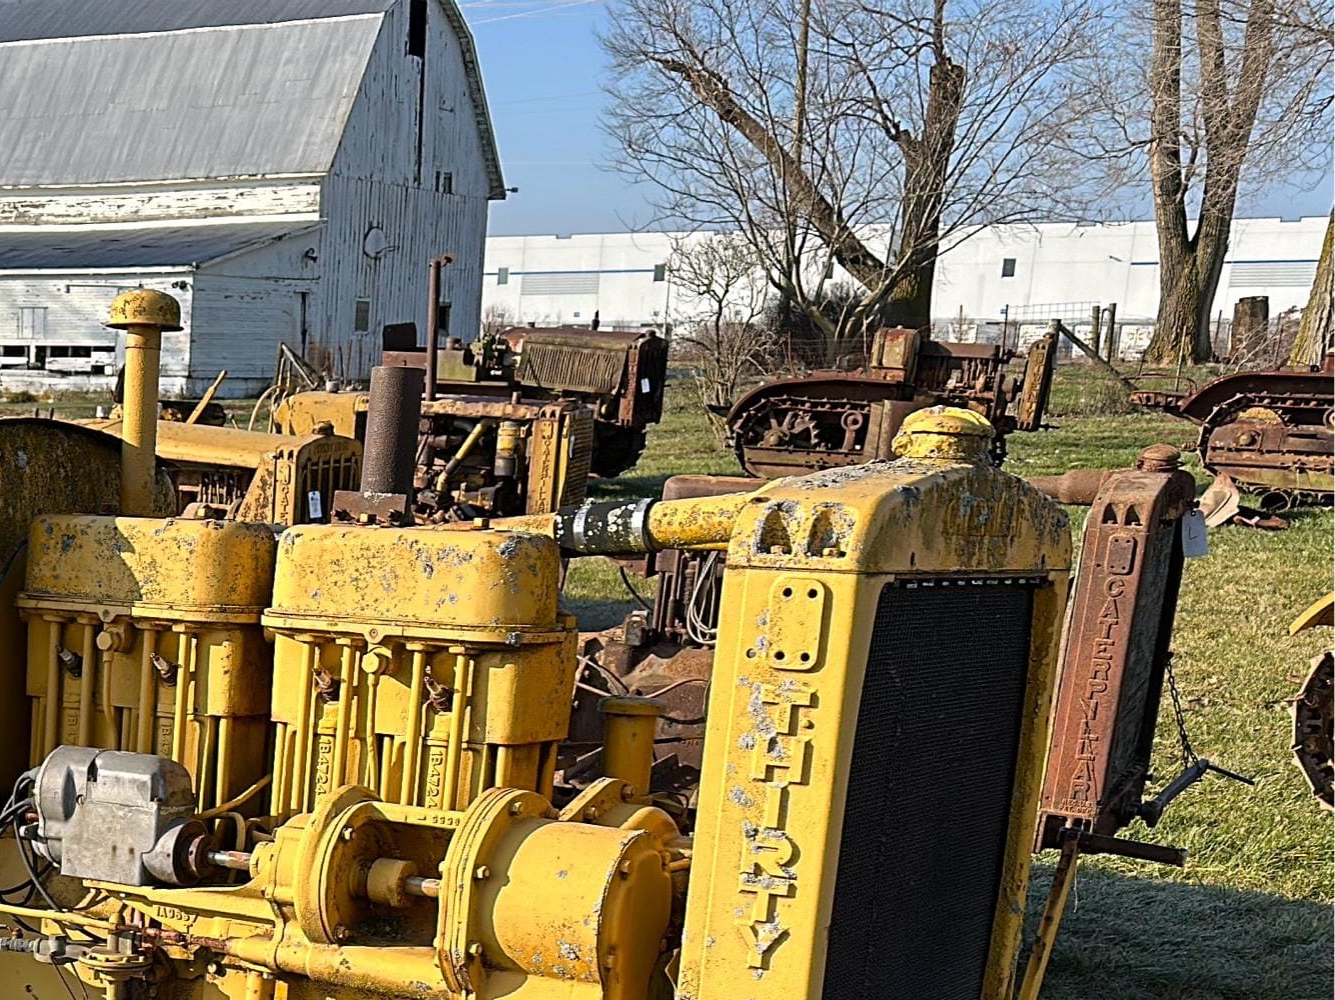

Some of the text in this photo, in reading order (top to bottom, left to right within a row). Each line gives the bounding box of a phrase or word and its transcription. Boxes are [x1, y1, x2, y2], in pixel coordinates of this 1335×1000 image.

[1069, 578, 1125, 801] CATERPILLAR
[315, 738, 332, 797] 1B4724
[426, 750, 444, 809] 1B4724
[735, 684, 818, 970] THIRTY
